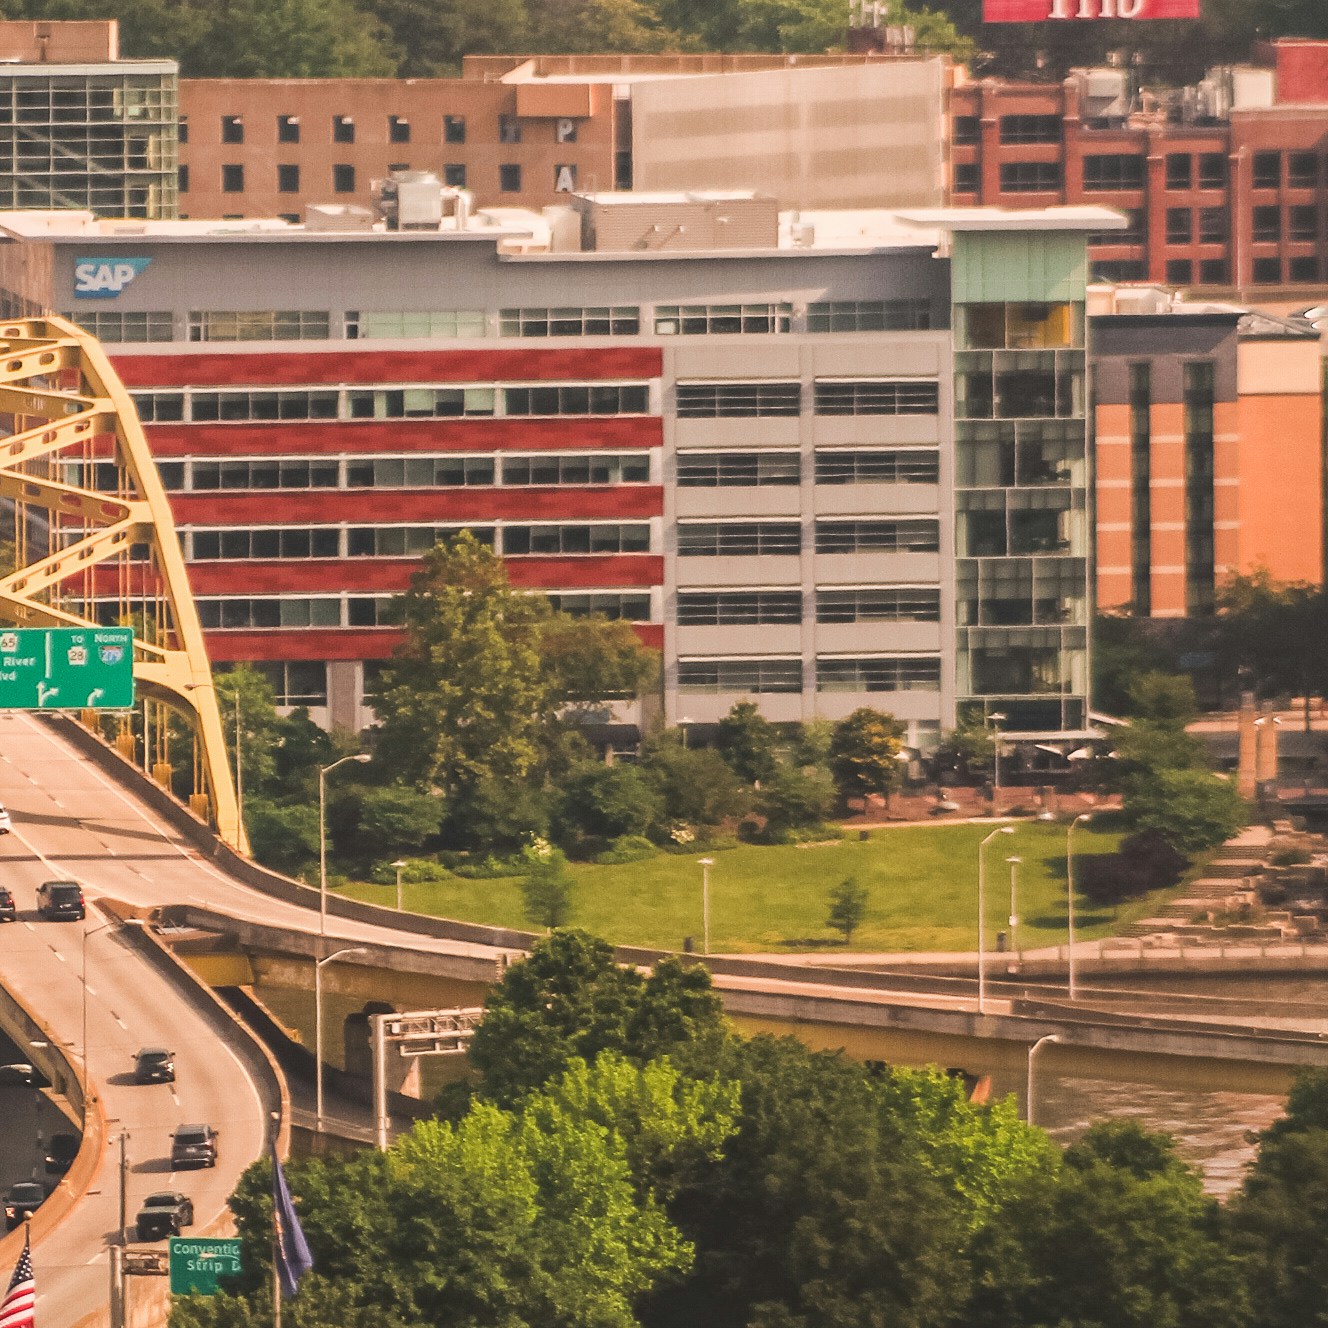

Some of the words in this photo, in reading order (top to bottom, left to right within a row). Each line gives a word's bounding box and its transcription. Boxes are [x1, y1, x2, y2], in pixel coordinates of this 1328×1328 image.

[75, 264, 134, 291] SAP
[1, 638, 16, 647] 65
[71, 635, 84, 643] TO
[94, 634, 128, 643] NORTH
[3, 656, 36, 666] River
[70, 651, 83, 661] 28
[187, 1259, 223, 1273] Strip
